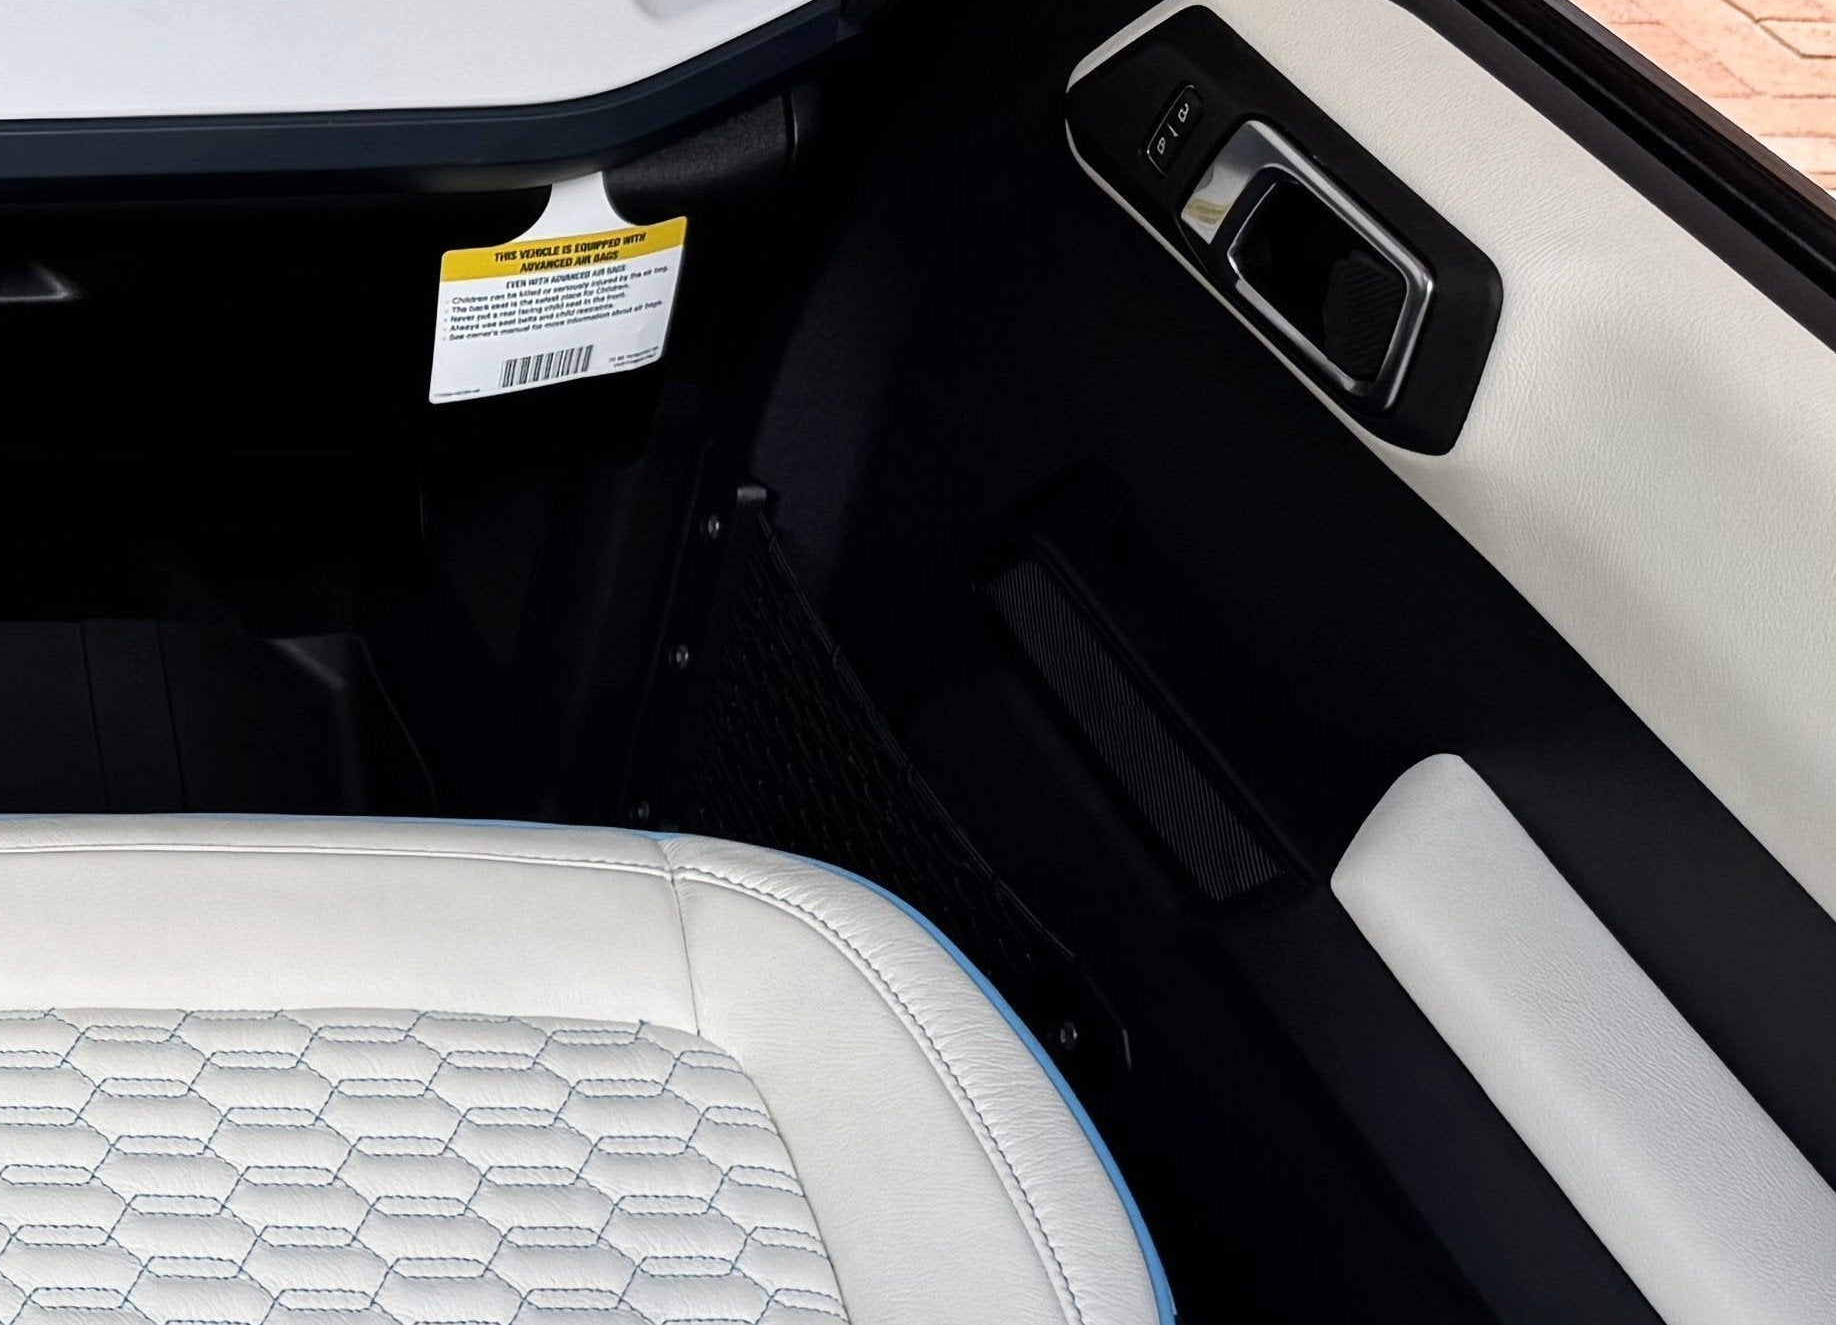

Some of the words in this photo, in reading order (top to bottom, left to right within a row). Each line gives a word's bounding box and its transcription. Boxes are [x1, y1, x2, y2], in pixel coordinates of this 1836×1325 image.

[495, 251, 517, 262] THIS
[520, 246, 558, 259] VEHICLE
[562, 245, 572, 254] IS
[575, 238, 621, 253] EQUIPPED
[520, 258, 573, 273] ADVANCED
[573, 254, 591, 266] AIR
[593, 250, 619, 263] BAGS
